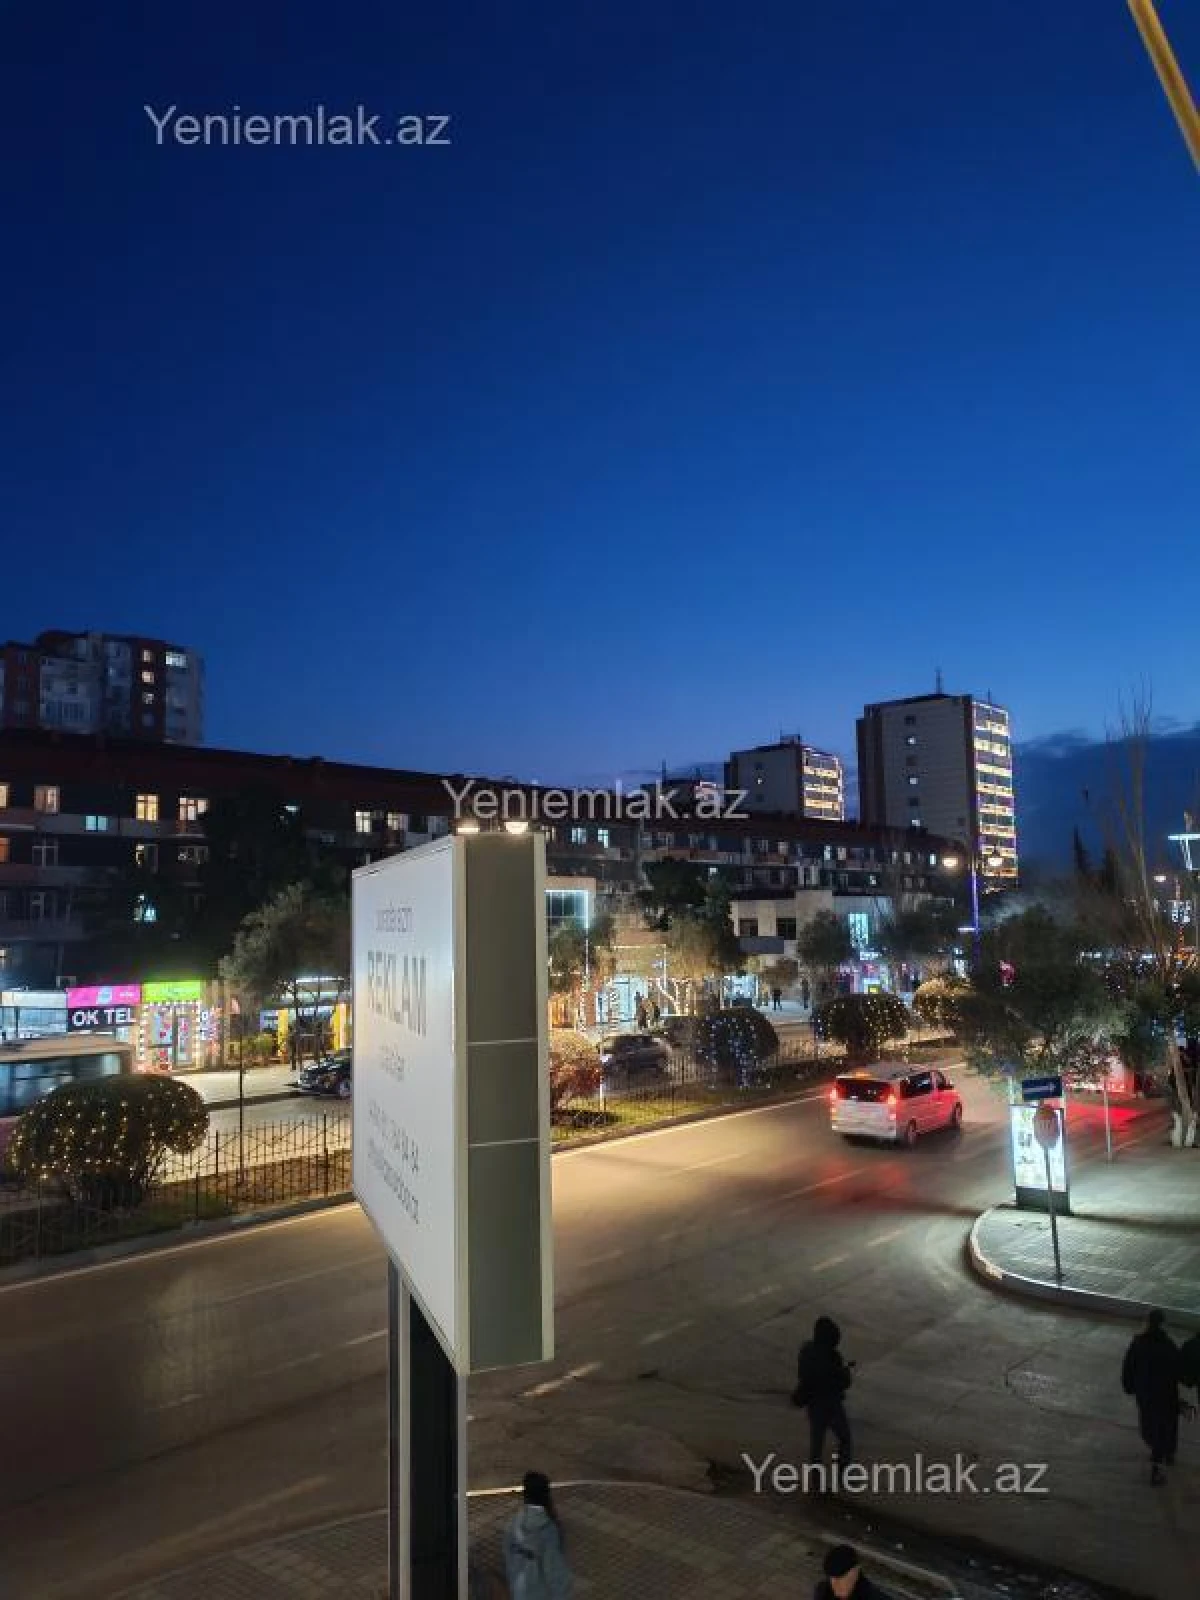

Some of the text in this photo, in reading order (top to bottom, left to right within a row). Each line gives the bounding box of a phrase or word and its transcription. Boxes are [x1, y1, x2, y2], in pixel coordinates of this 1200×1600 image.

[73, 1008, 136, 1026] OK TEL
[367, 951, 427, 1038] REKLAM
